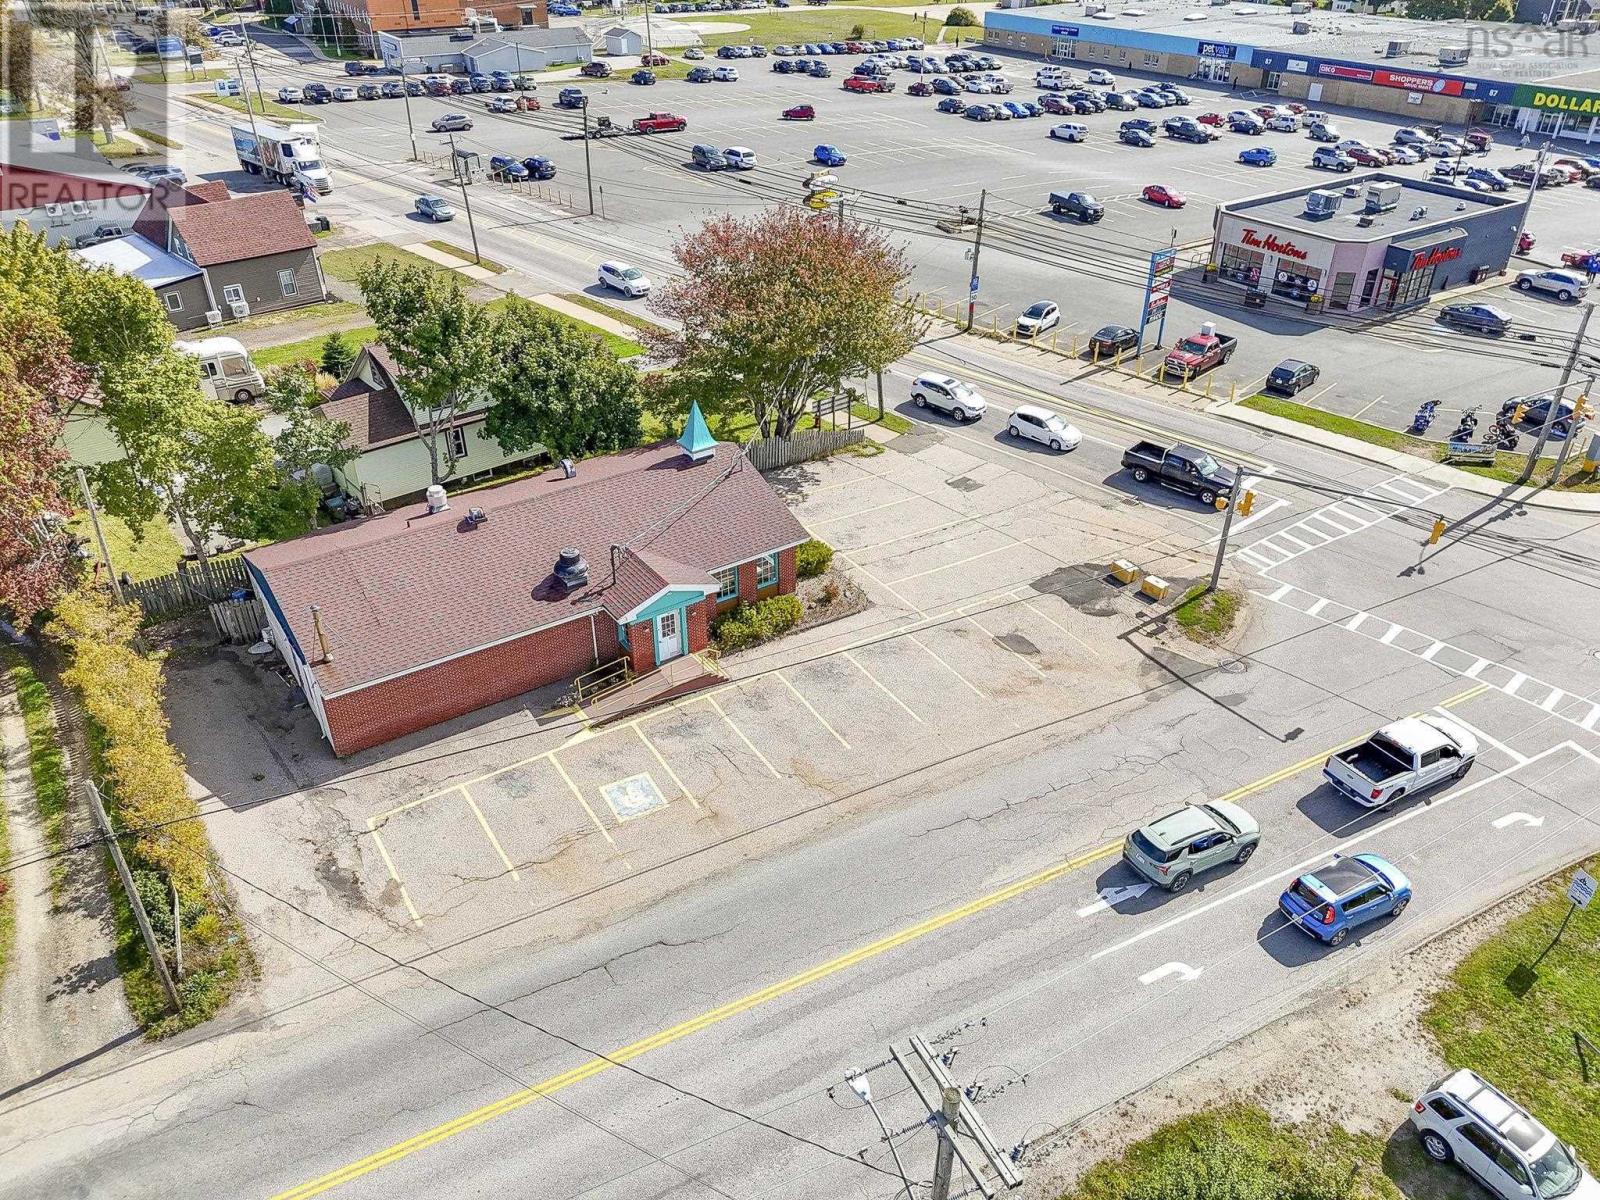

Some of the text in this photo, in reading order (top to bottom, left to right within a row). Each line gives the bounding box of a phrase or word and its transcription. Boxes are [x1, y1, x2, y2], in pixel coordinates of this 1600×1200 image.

[1389, 74, 1433, 87] SHOPPERS
[1488, 89, 1498, 97] 87
[1241, 228, 1308, 260] Tim Hortons
